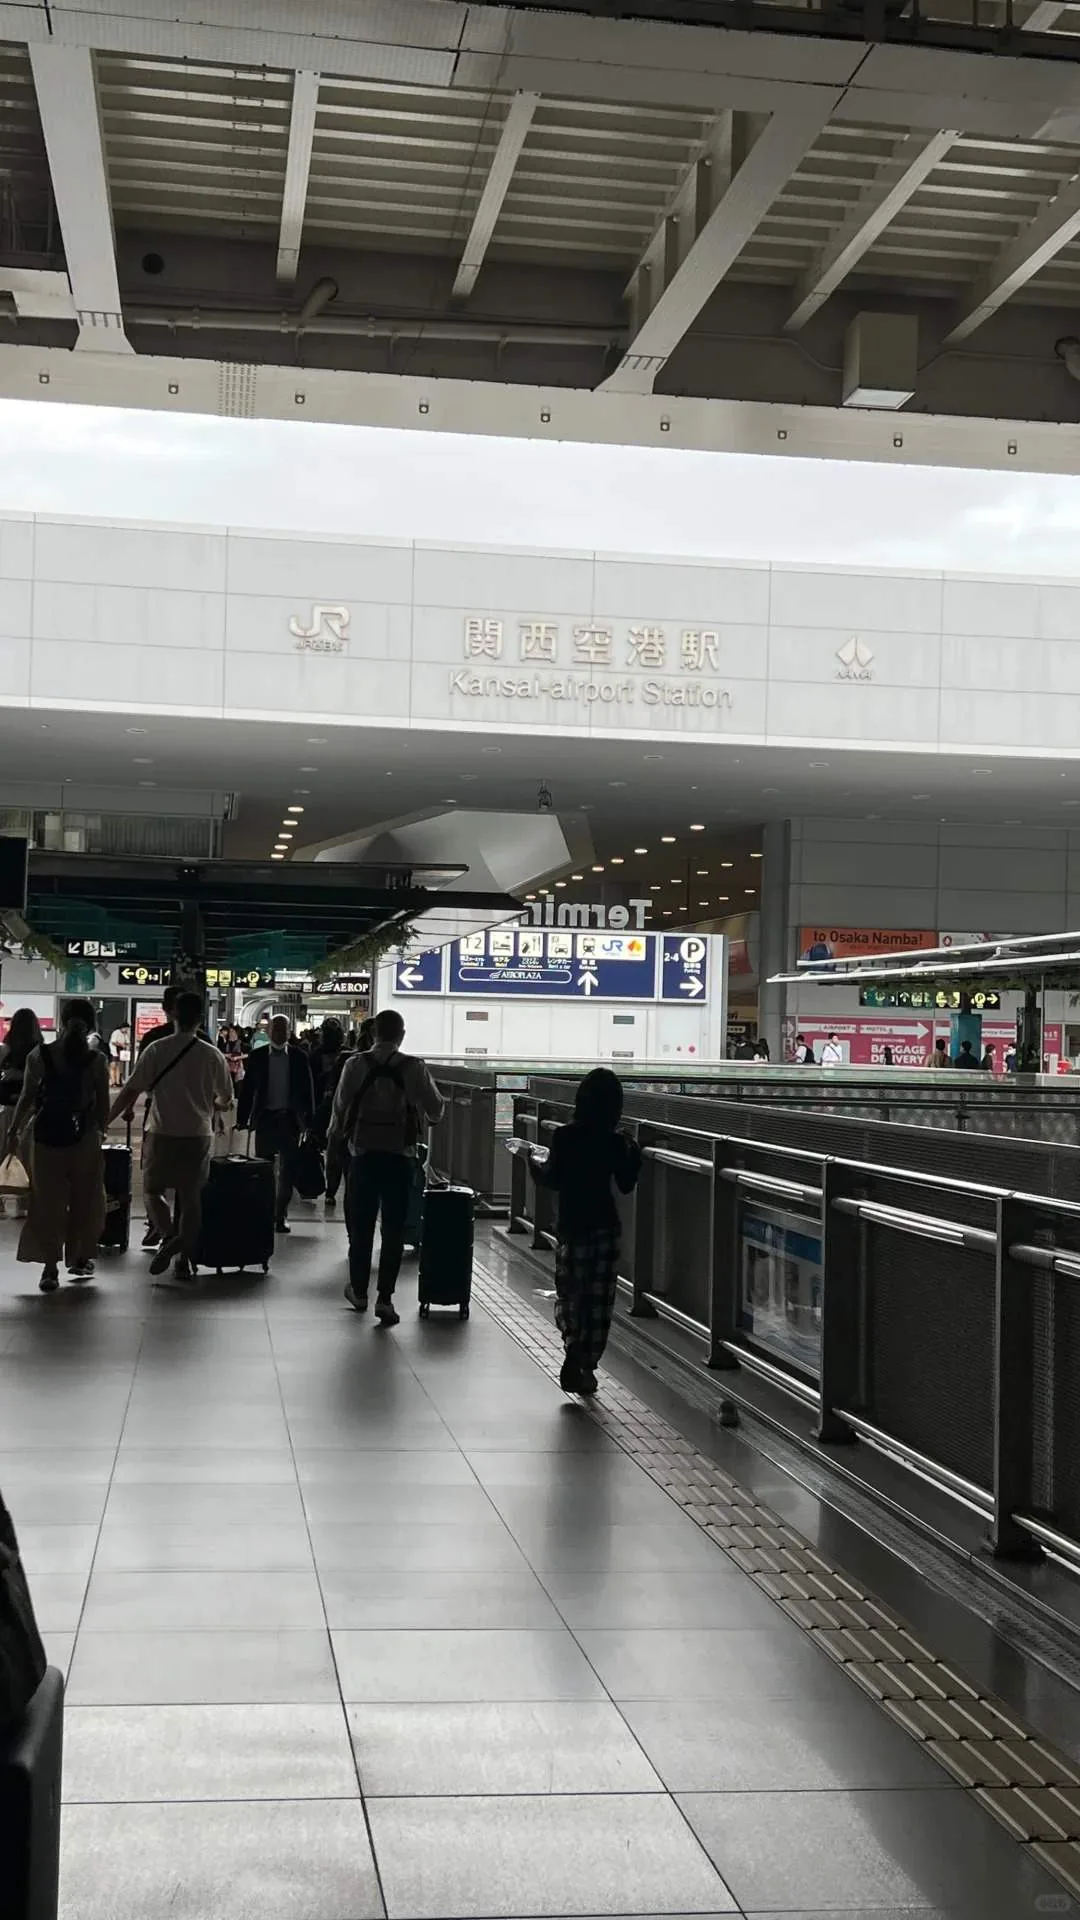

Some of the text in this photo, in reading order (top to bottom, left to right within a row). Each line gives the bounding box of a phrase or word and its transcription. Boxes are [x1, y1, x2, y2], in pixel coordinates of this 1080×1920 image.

[288, 603, 350, 640] JR
[464, 616, 720, 671] 関西空港駅
[449, 668, 734, 709] Kansai-airport Station
[602, 939, 623, 952] JR
[813, 931, 923, 946] to Osaka Namba!
[687, 941, 700, 958] P
[502, 971, 543, 980] AEROPLAZA
[333, 983, 369, 993] AEROP
[871, 1054, 925, 1064] DEIVERY
